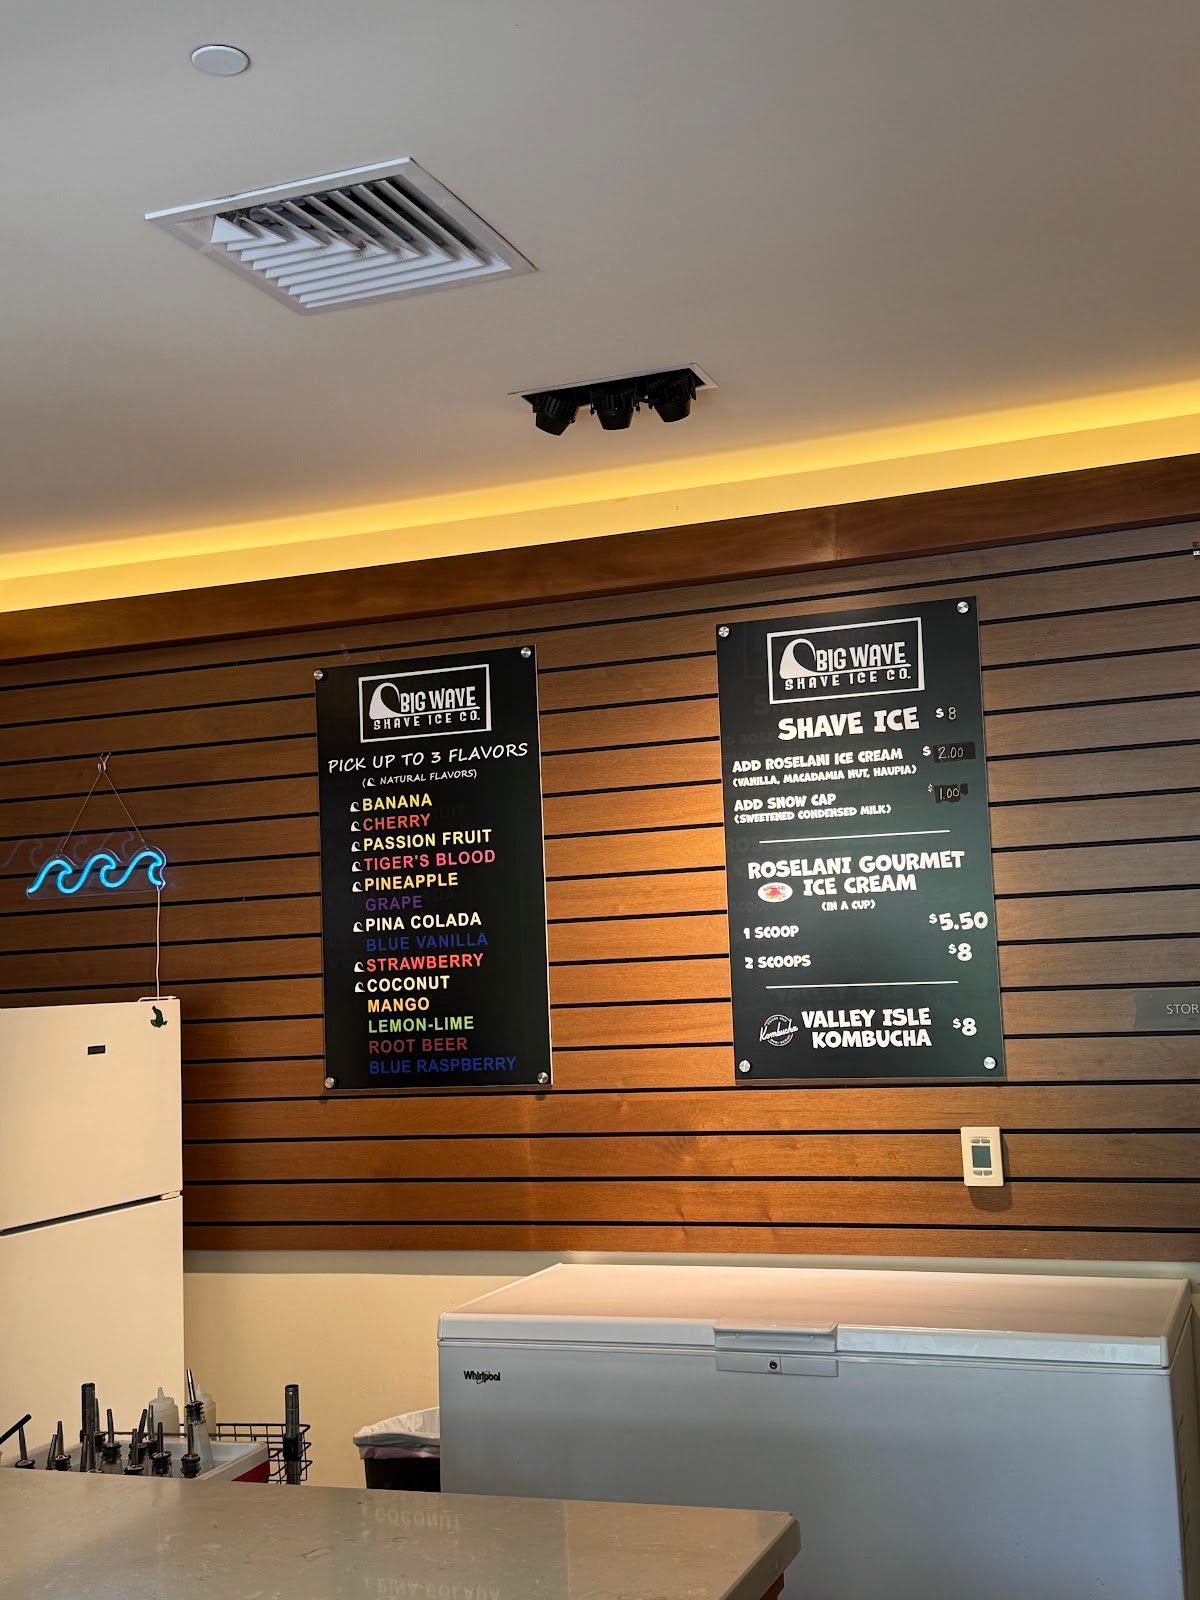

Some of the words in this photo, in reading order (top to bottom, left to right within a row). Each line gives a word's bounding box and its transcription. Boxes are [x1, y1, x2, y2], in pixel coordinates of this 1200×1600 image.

[816, 648, 846, 672] BIG
[849, 642, 905, 666] WAVE
[785, 675, 839, 690] SHAVE
[849, 671, 877, 684] ICE
[886, 668, 911, 680] CO.
[400, 691, 425, 713] BIG
[429, 686, 476, 709] WAVE
[373, 716, 420, 730] SHAVE
[427, 712, 451, 725] ICE
[459, 710, 480, 721] CO.
[778, 712, 863, 740] SHAVE
[874, 707, 919, 732] ICE
[328, 757, 366, 773] PICK
[373, 755, 395, 768] UP
[401, 752, 424, 766] TO
[431, 752, 441, 763] 3
[449, 743, 527, 762] FLAVORS
[732, 760, 761, 772] ADD
[766, 754, 830, 770] ROSELANI
[835, 752, 853, 765] ICE
[858, 748, 903, 763] CREAM
[430, 769, 477, 780] FLAVORS)
[733, 775, 780, 787] (VANILLA,
[783, 770, 845, 783] MACADAMIA
[848, 768, 870, 779] NUT,
[873, 765, 916, 776] HAUPIA)
[363, 793, 432, 811] BANANA
[734, 799, 763, 811] ADD
[767, 796, 807, 809] SNOW
[811, 793, 836, 806] CAP
[363, 814, 430, 831] CHERRY
[734, 809, 795, 824] (SWEETENED
[797, 806, 857, 819] CONDENSED
[860, 804, 891, 815] MILK)
[364, 833, 435, 851] PASSION
[443, 829, 491, 845] FRUIT
[364, 854, 429, 870] TIGER'S
[436, 850, 495, 866] BLOOD
[748, 857, 851, 879] ROSELANI
[859, 851, 964, 873] GOURMET
[365, 872, 458, 891] PINEAPPLE
[803, 878, 837, 896] ICE
[844, 874, 917, 893] CREAM
[365, 895, 422, 911] GRAPE
[822, 901, 837, 911] (IN
[841, 901, 849, 910] A
[851, 899, 875, 909] CUP)
[366, 917, 404, 931] PINA
[411, 912, 481, 929] COLADA
[929, 911, 988, 930] $5.50
[367, 937, 409, 951] BLUE
[416, 932, 488, 948] VANILLA
[744, 928, 750, 939] 1
[755, 925, 799, 938] SCOOP
[949, 943, 972, 961] $8
[367, 953, 483, 972] STRAWBERRY
[745, 957, 753, 969] 2
[758, 955, 811, 968] SCOOPS
[367, 975, 450, 992] COCONUT
[368, 997, 429, 1012] MANGO
[369, 1016, 474, 1033] LEMON-LIME
[801, 1009, 875, 1028] VALLEY
[883, 1008, 931, 1026] ISLE
[953, 1018, 977, 1036] $8
[759, 1017, 799, 1042] Kombucha
[812, 1029, 932, 1048] KOMBUCHA
[369, 1039, 415, 1054] ROOT
[422, 1037, 467, 1051] BEER
[369, 1060, 411, 1074] BLUE
[417, 1056, 516, 1072] RASPBERRY
